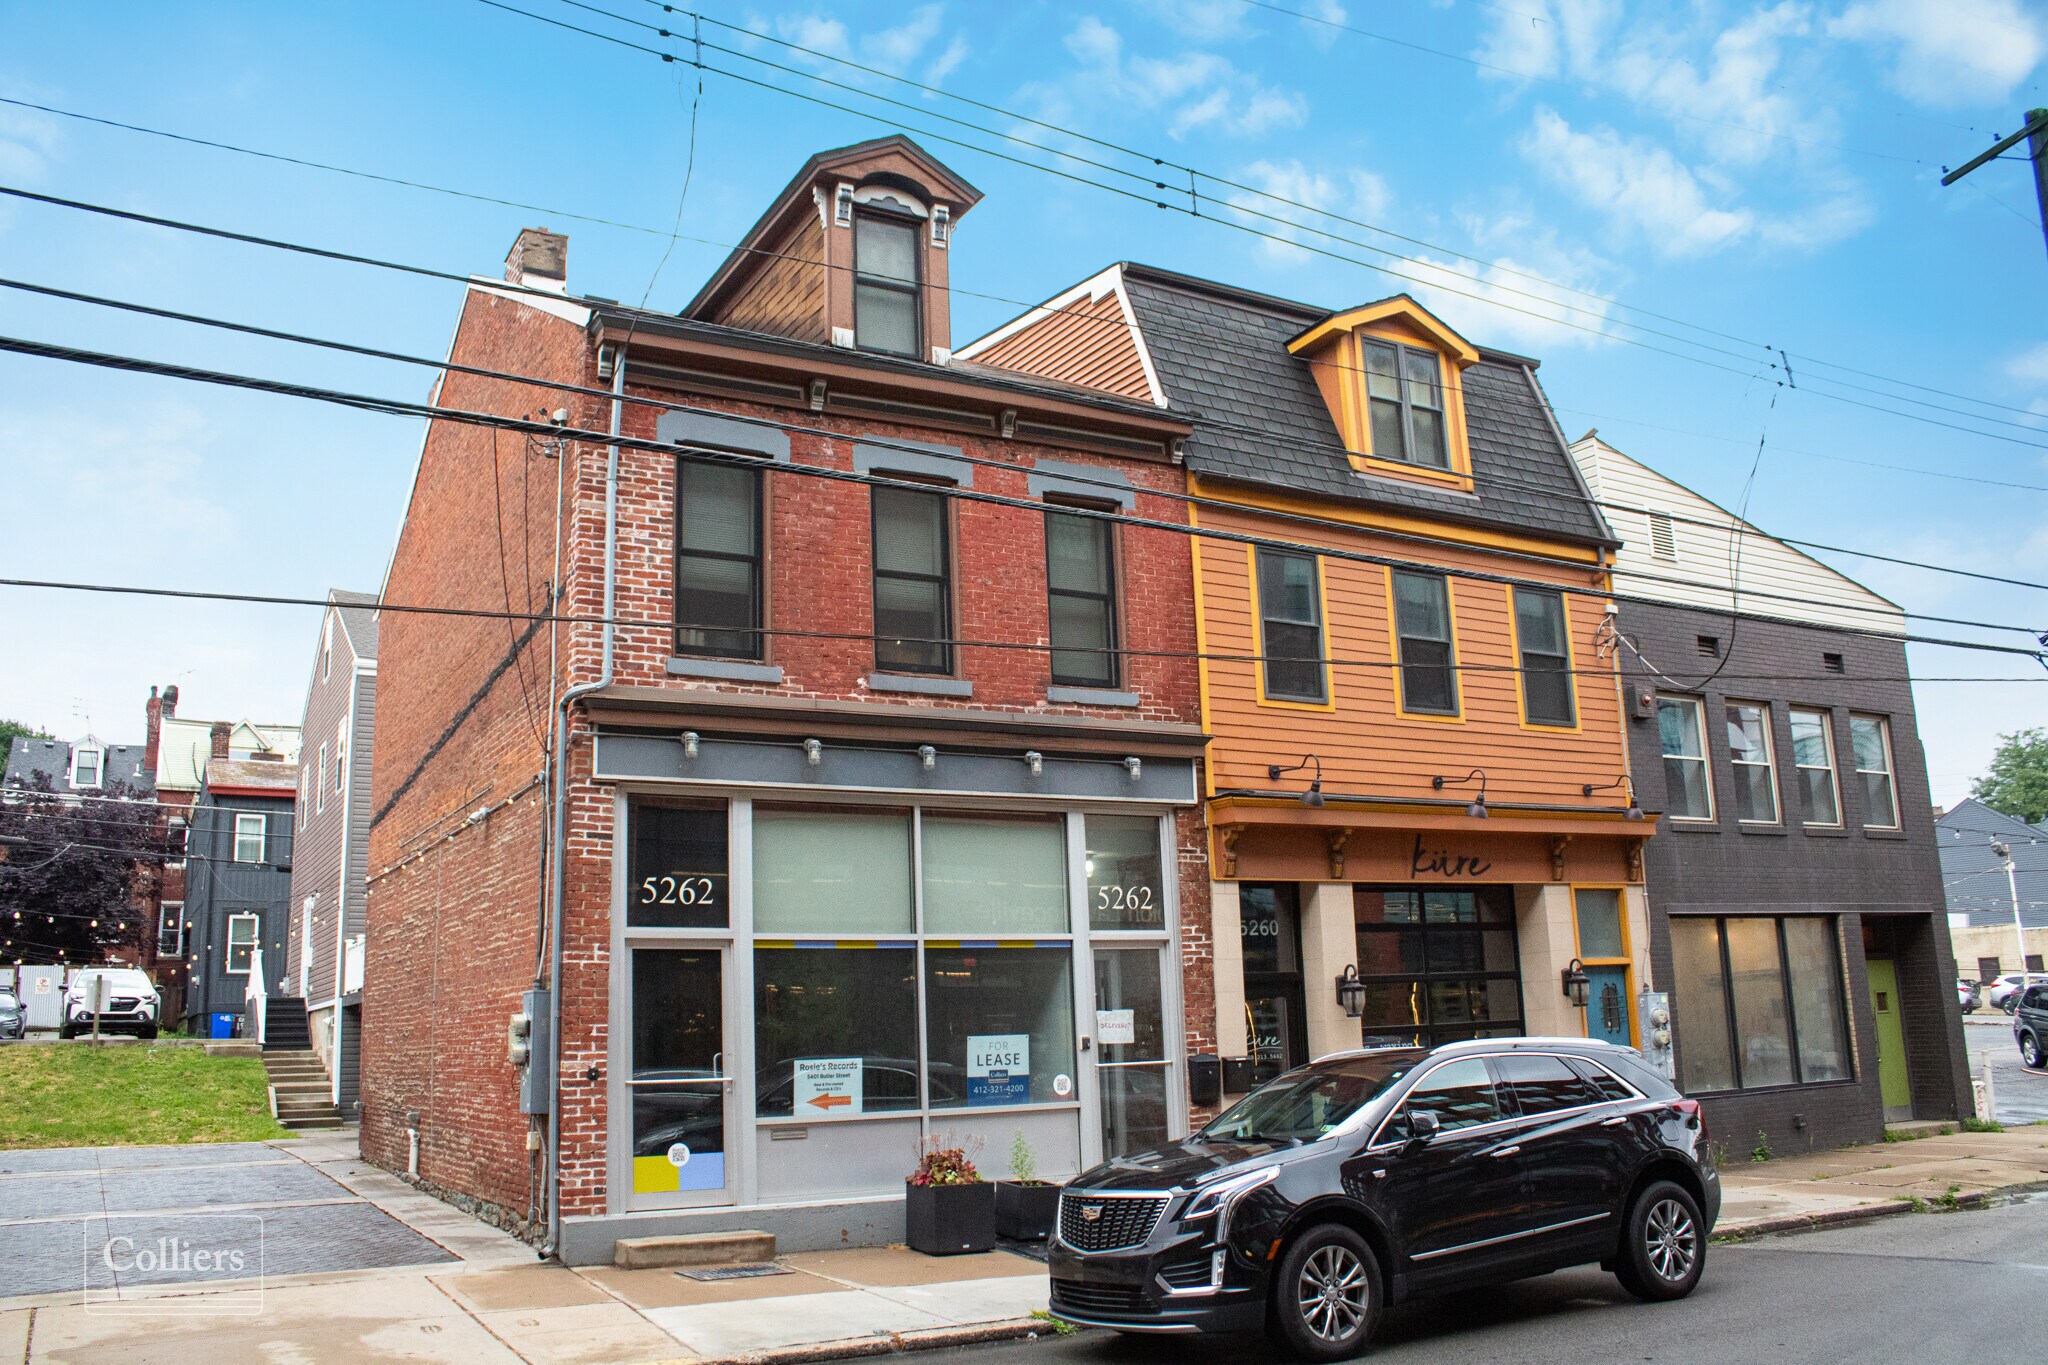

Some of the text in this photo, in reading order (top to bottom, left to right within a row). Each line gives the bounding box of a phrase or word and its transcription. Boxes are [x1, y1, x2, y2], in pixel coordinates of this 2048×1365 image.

[641, 876, 714, 905] 5262
[1098, 886, 1153, 910] 5262
[988, 1041, 1009, 1051] FOR
[977, 1053, 1020, 1067] LEASE
[800, 1062, 858, 1071] Rosie's Records
[973, 1084, 1024, 1094] 412-321-4200
